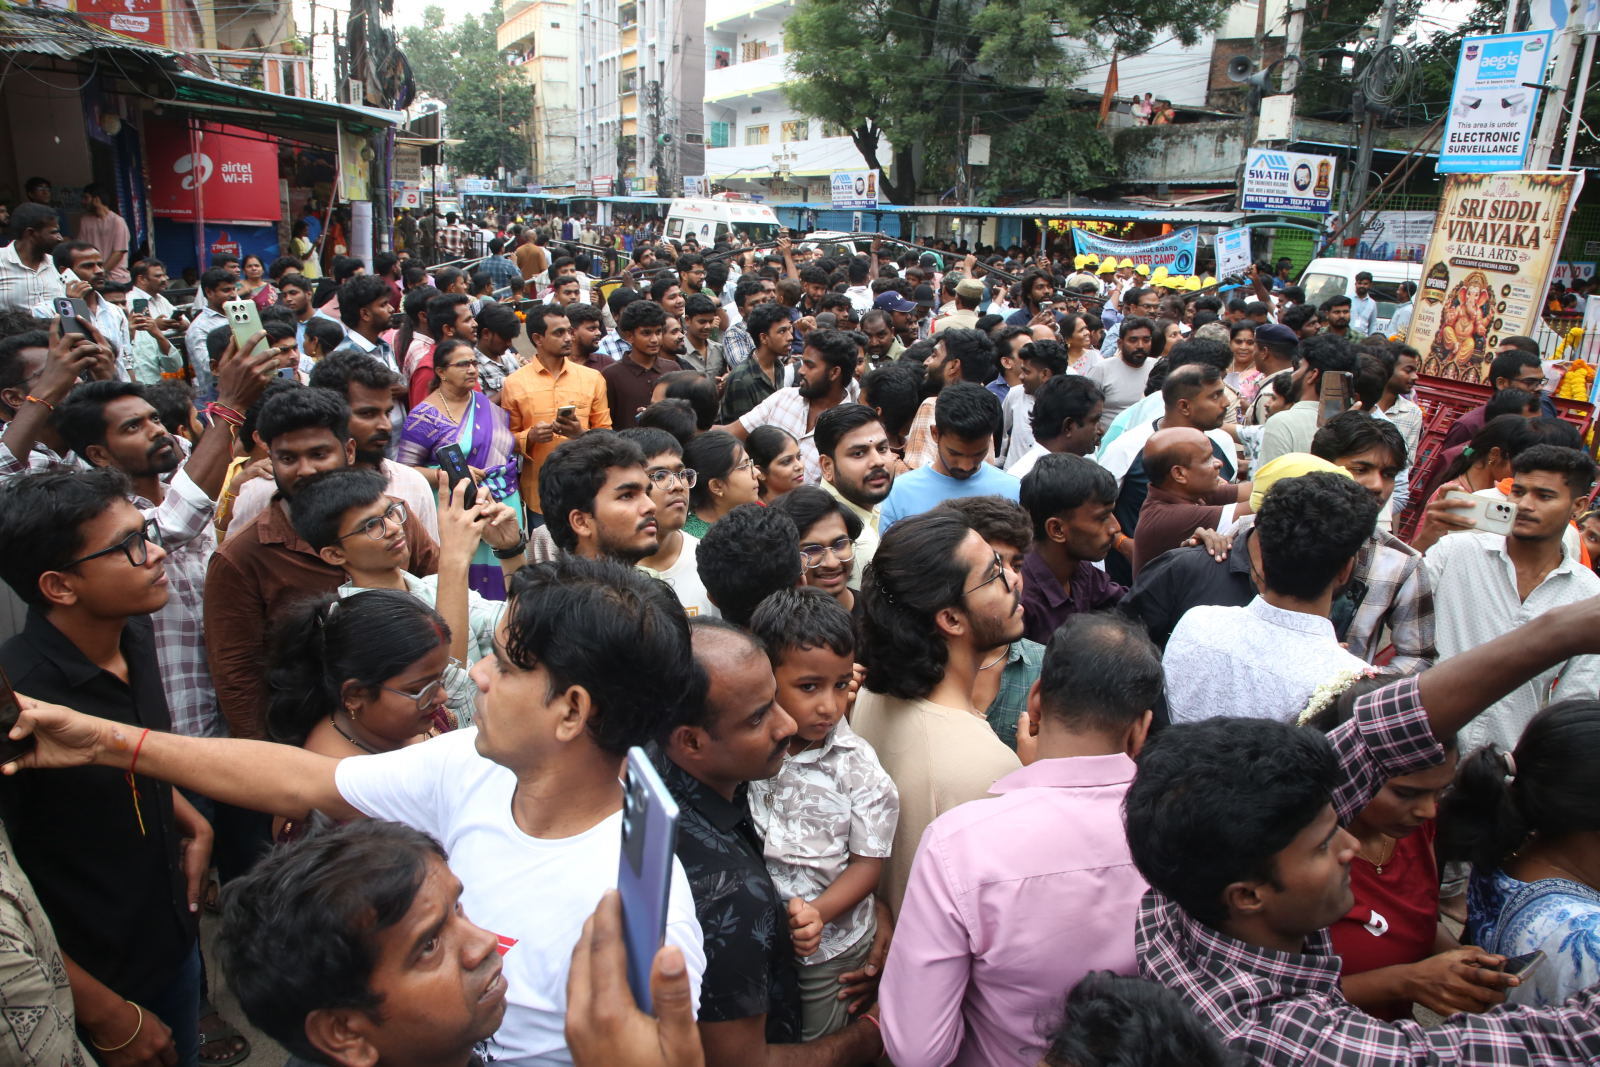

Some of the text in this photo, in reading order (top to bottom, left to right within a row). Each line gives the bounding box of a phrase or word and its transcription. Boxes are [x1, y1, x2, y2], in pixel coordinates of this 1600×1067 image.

[1480, 51, 1520, 70] aegis
[1450, 132, 1521, 143] ELECTRONIC
[1448, 145, 1519, 153] SURVEILLANCE
[221, 161, 252, 173] airtel
[222, 173, 253, 184] Wi-Fi
[1249, 169, 1289, 181] SWATHI
[1290, 198, 1303, 206] TECH
[1457, 198, 1542, 223] SRI SIDDI
[1447, 220, 1540, 250] VINAYAKA
[1456, 244, 1518, 262] KALA ARTS
[1155, 254, 1176, 265] CAMP
[1426, 278, 1448, 289] OPENING
[1418, 313, 1435, 323] BAPPA
[1415, 327, 1431, 336] HOME
